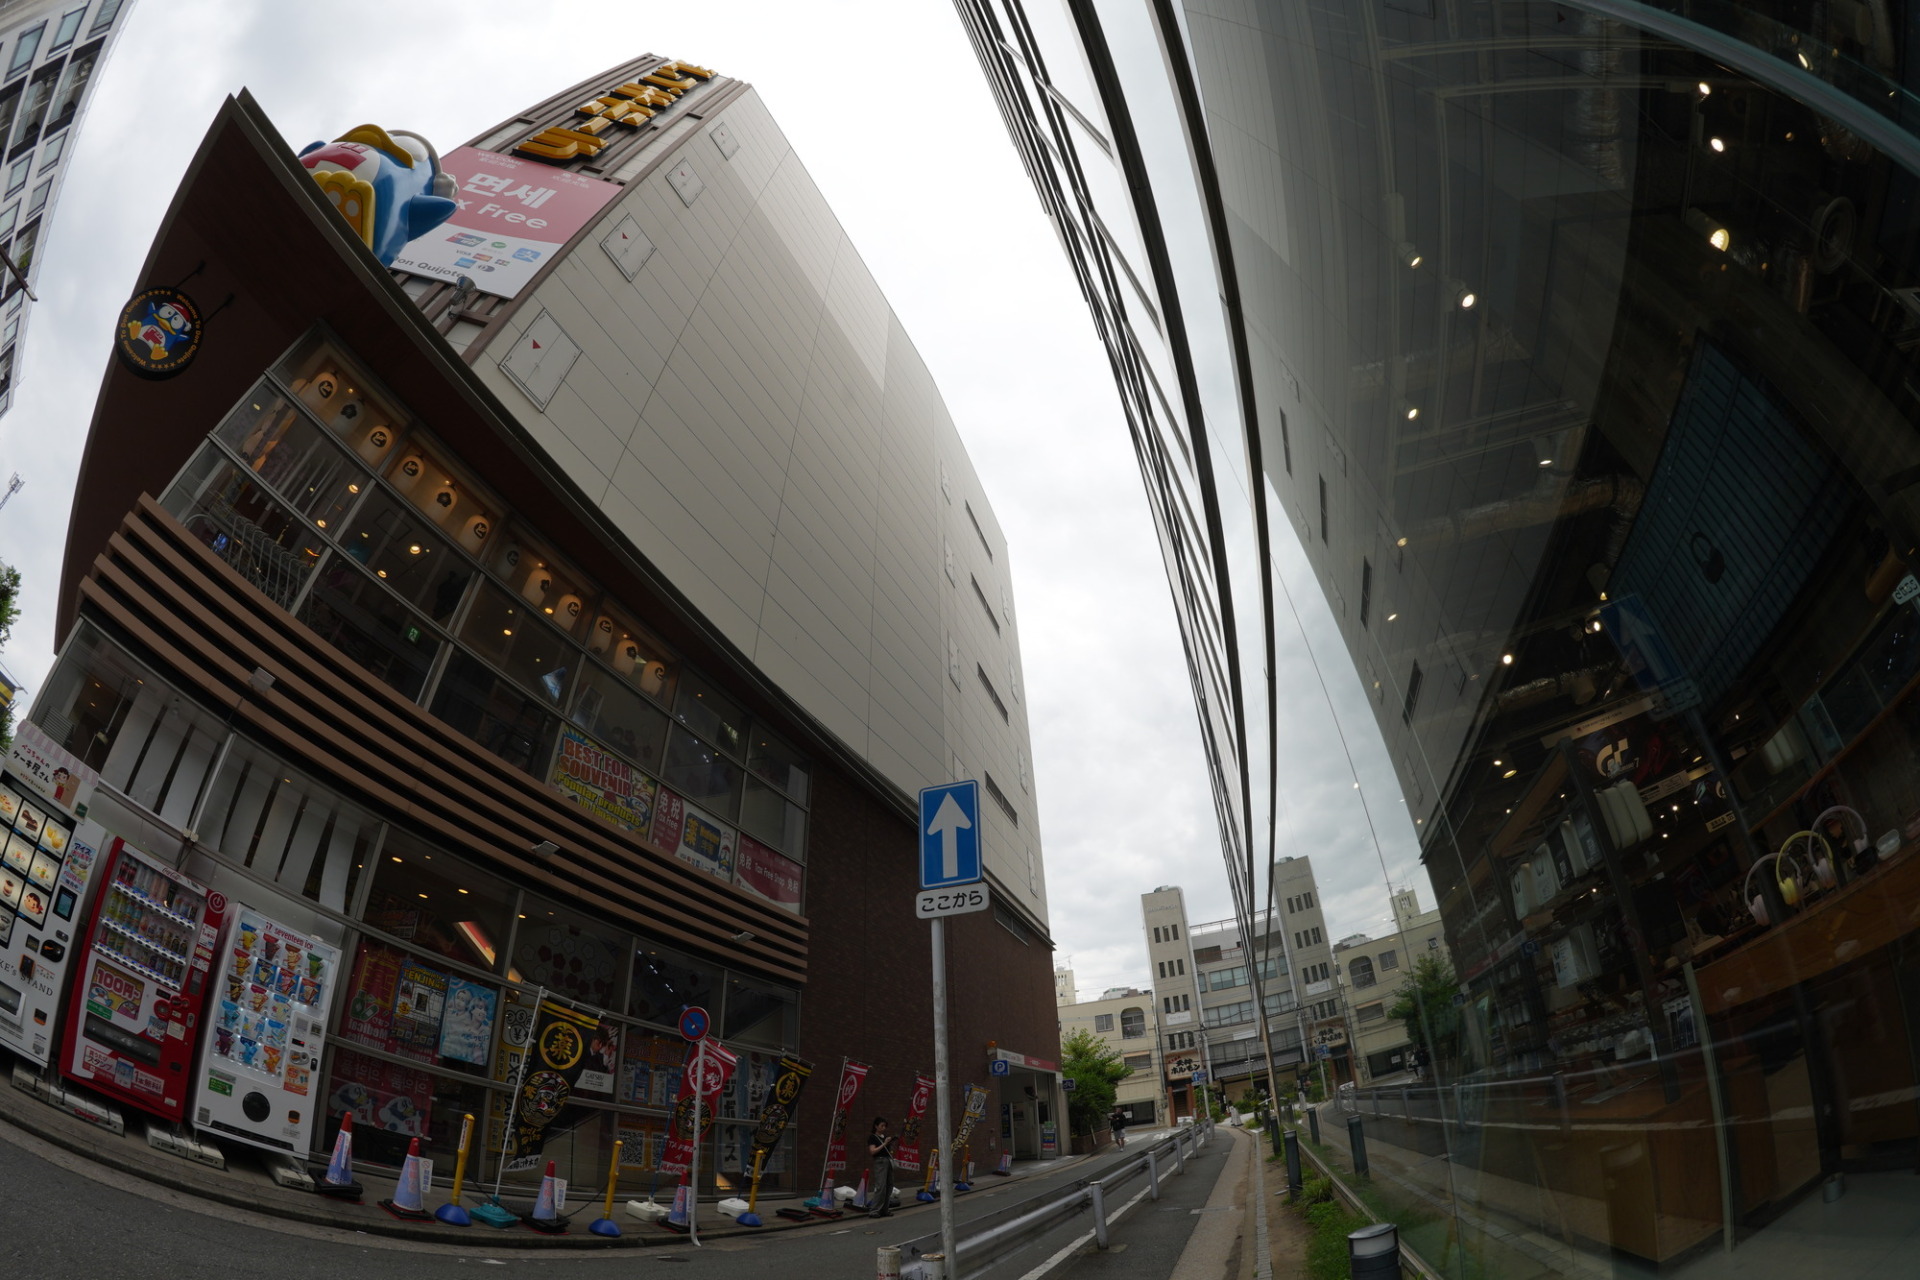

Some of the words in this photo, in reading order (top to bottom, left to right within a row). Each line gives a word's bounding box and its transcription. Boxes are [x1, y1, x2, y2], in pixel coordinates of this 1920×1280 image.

[463, 172, 558, 209] 면세
[477, 203, 548, 230] Free
[120, 313, 129, 328] Don
[126, 294, 147, 313] Quijote
[193, 330, 202, 344] Don
[176, 344, 197, 364] Quijote
[13, 749, 50, 783] ケーキ屋さん
[563, 736, 602, 768] BEST
[603, 753, 632, 781] FOR
[558, 754, 633, 798] SOUVENIR
[556, 772, 598, 802] Popular
[597, 795, 642, 827] products
[578, 796, 590, 810] in
[658, 791, 682, 820] 免税
[656, 809, 666, 824] Tax
[666, 815, 679, 831] Free
[763, 866, 774, 881] Free
[921, 889, 984, 912] ここから
[274, 926, 304, 948] seventeen
[303, 939, 315, 951] ice
[403, 968, 436, 988] TENJIN
[549, 1025, 574, 1061] 薬
[1170, 1063, 1201, 1075] ホルモン
